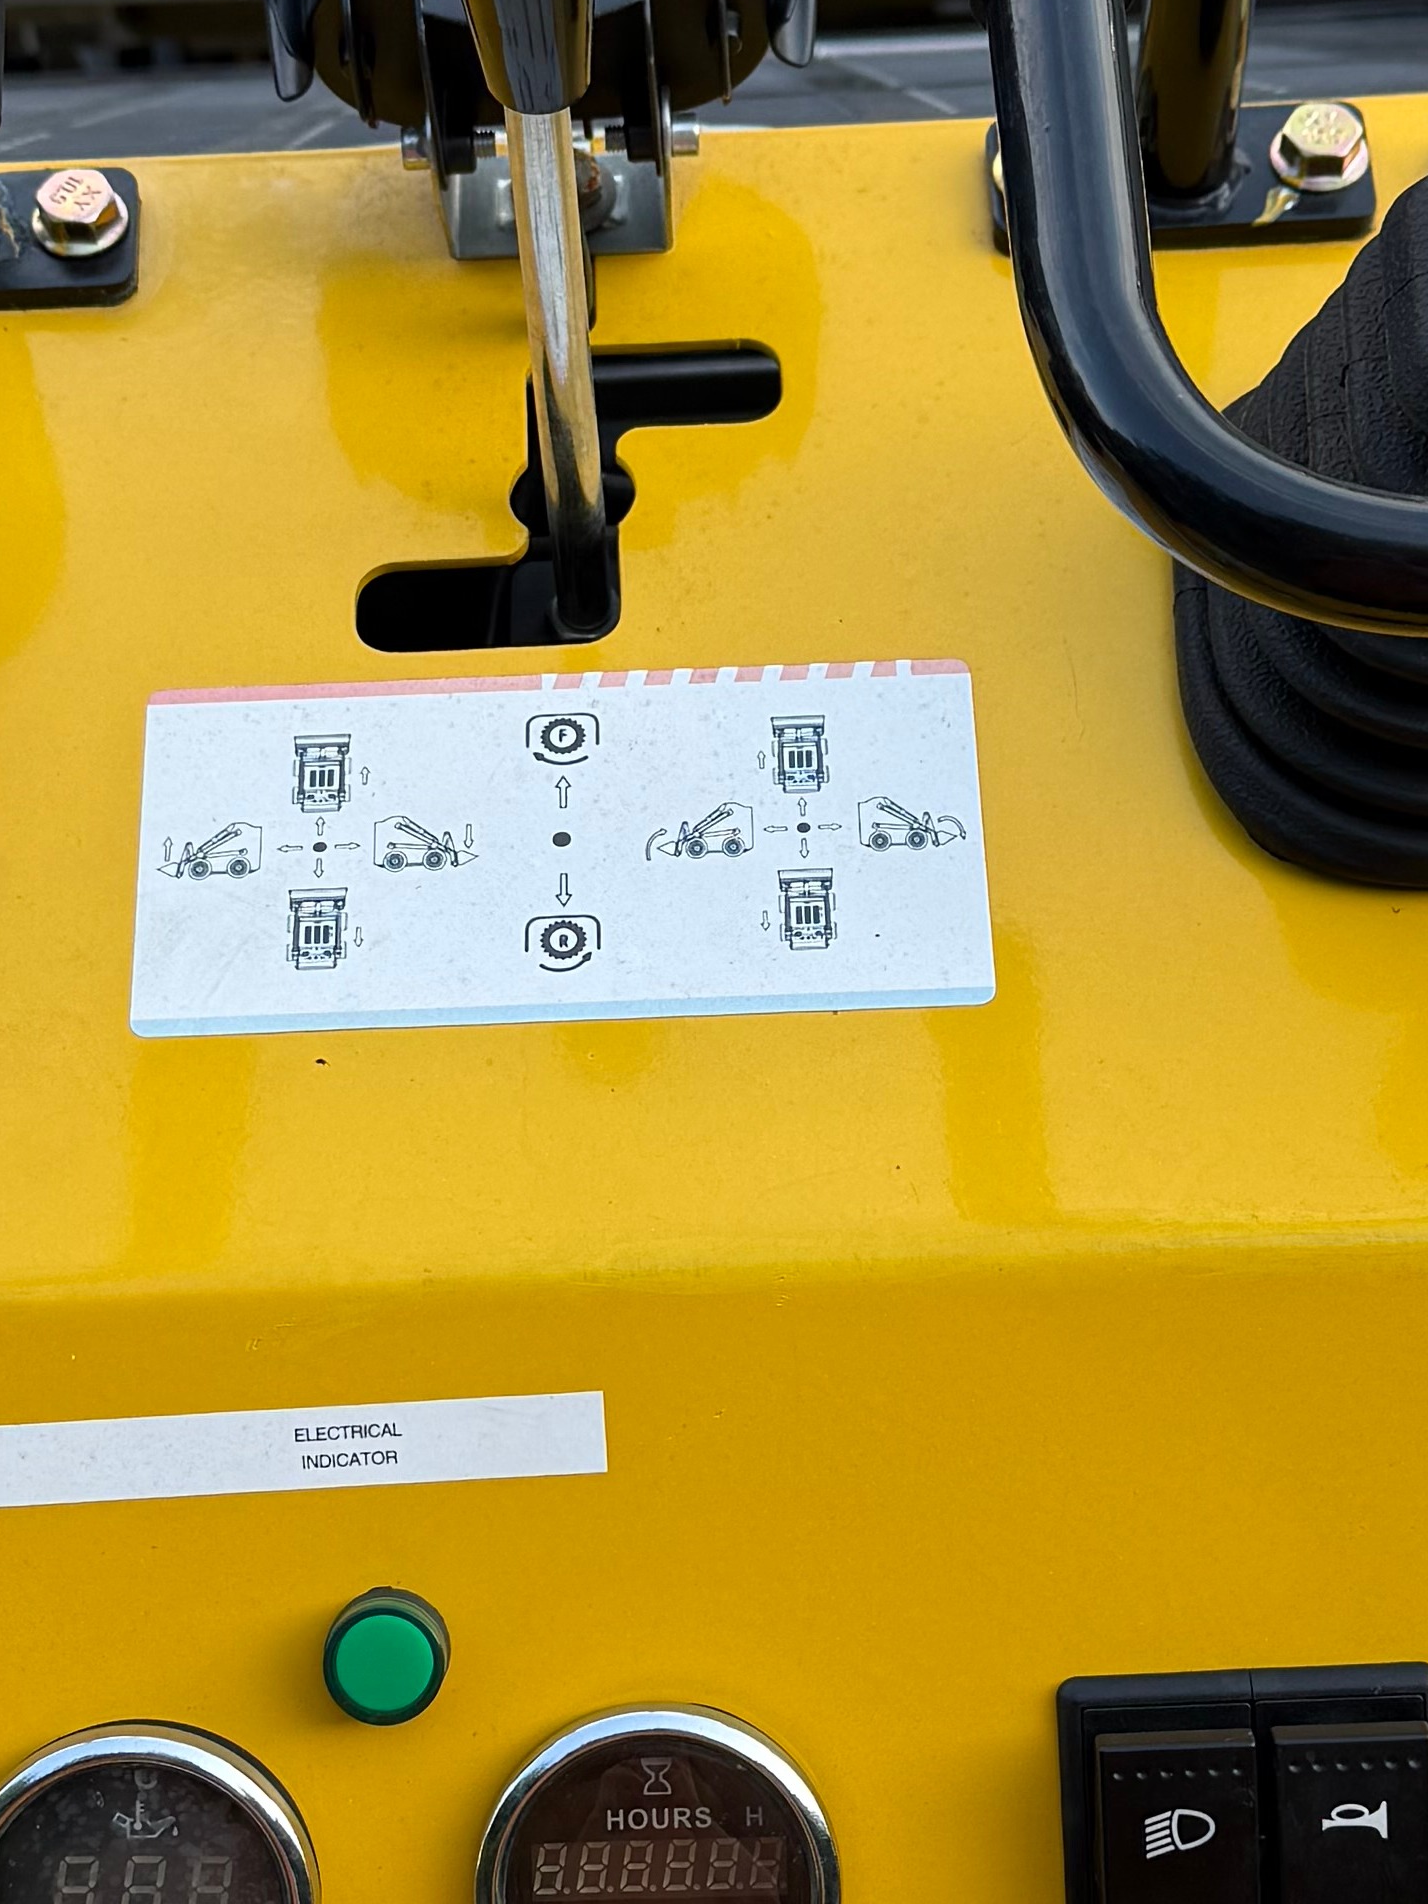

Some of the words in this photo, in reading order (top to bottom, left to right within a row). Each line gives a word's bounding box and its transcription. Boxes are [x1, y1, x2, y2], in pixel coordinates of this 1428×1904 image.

[559, 728, 568, 743] F
[559, 934, 569, 948] R
[294, 1422, 403, 1443] ELECTRICAL
[301, 1449, 399, 1470] INDICATOR
[606, 1806, 713, 1832] HOURS
[745, 1805, 765, 1827] H
